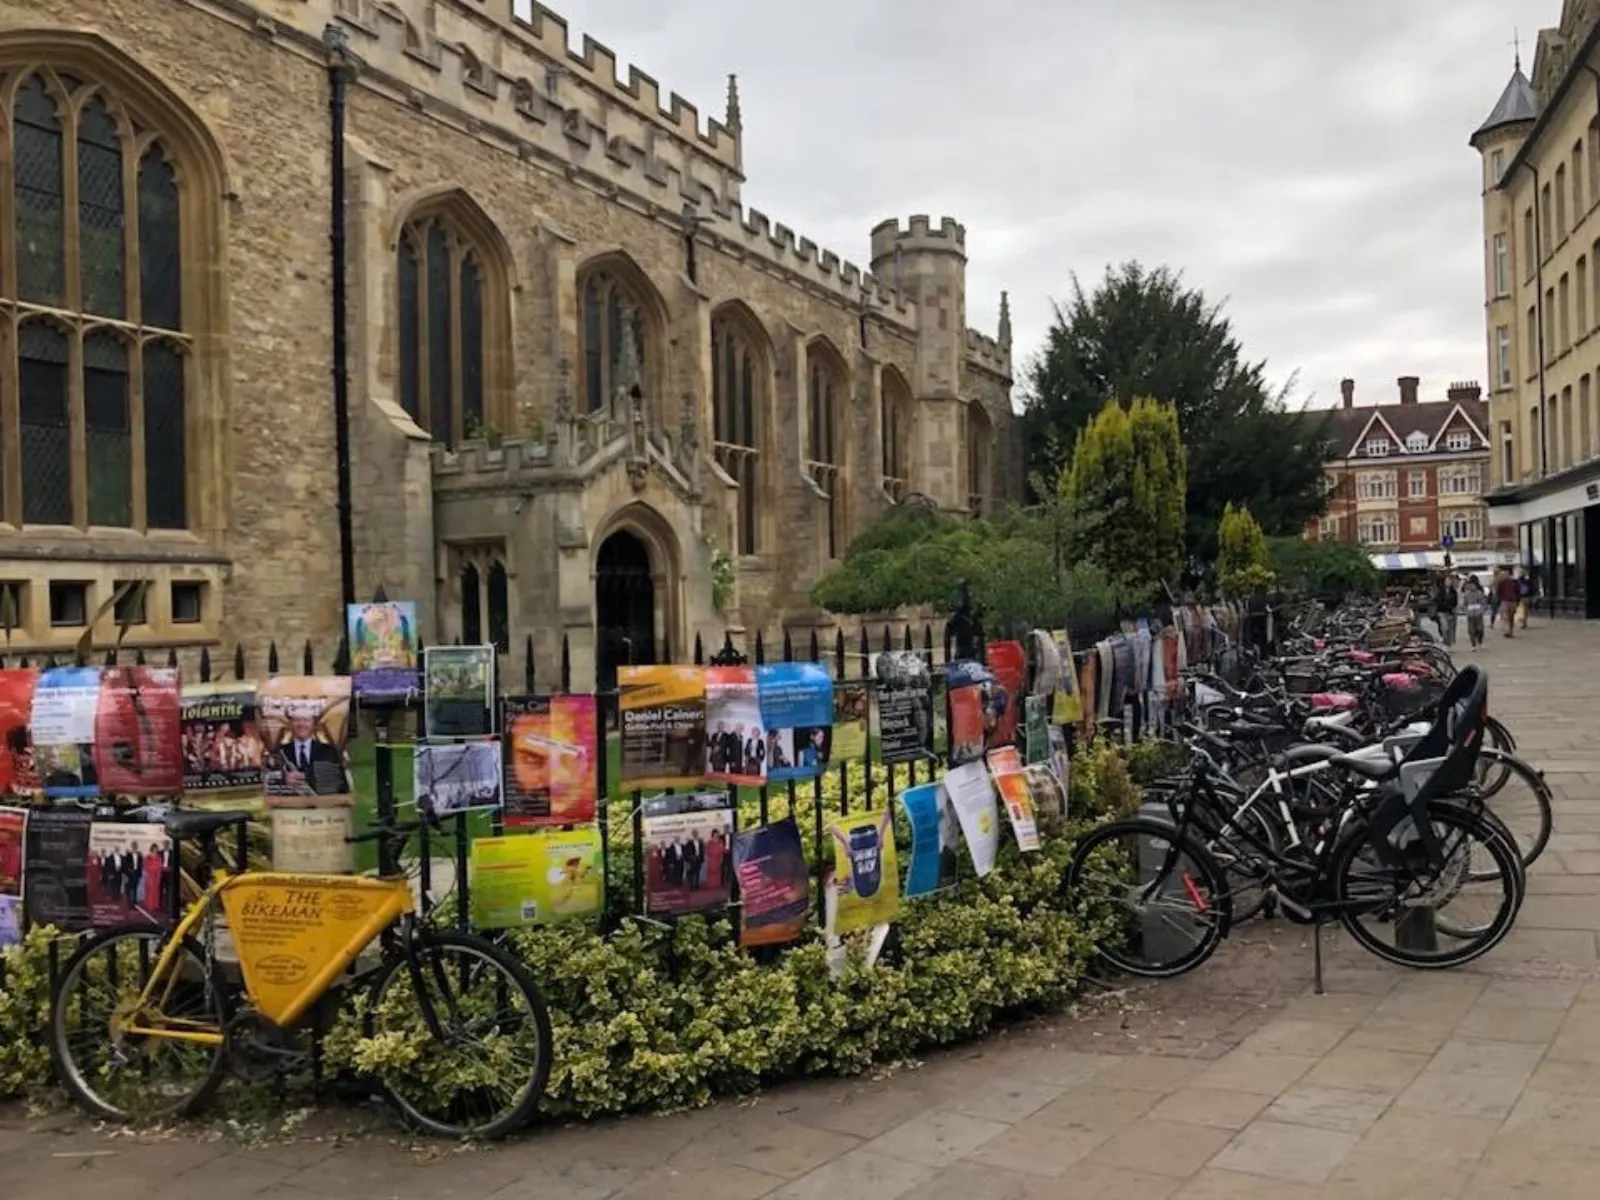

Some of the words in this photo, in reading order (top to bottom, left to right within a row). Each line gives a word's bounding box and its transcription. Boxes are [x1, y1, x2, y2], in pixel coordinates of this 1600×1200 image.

[624, 709, 662, 722] Daniel
[286, 889, 322, 905] THE
[241, 900, 323, 919] BIKEMAN
